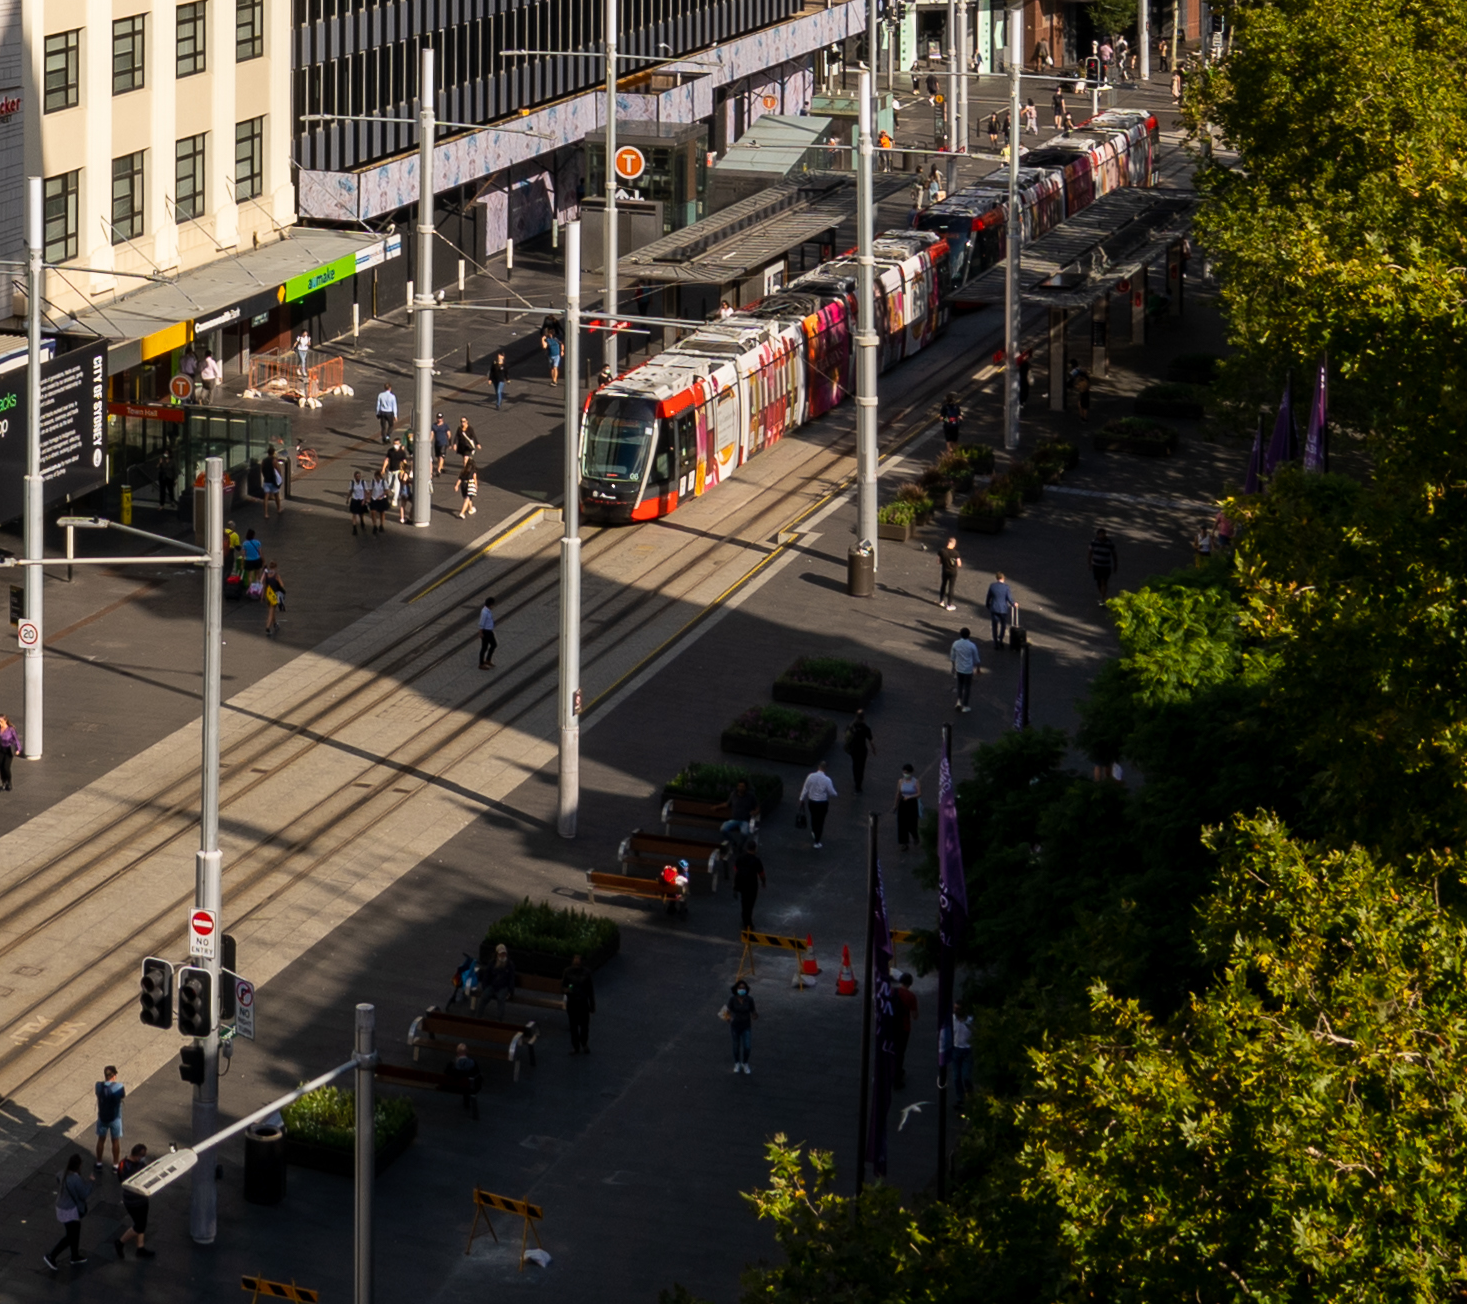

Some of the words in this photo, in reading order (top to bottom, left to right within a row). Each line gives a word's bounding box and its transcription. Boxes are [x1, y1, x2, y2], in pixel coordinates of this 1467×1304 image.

[622, 153, 636, 173] T
[92, 355, 103, 382] CITY
[92, 384, 103, 399] OF
[176, 381, 187, 395] T
[126, 407, 144, 416] Town
[144, 408, 158, 417] Hall
[92, 401, 103, 446] SYDNEY
[23, 628, 34, 639] 20
[196, 937, 209, 947] NO
[191, 946, 213, 956] ENTRY
[239, 1006, 250, 1019] NO
